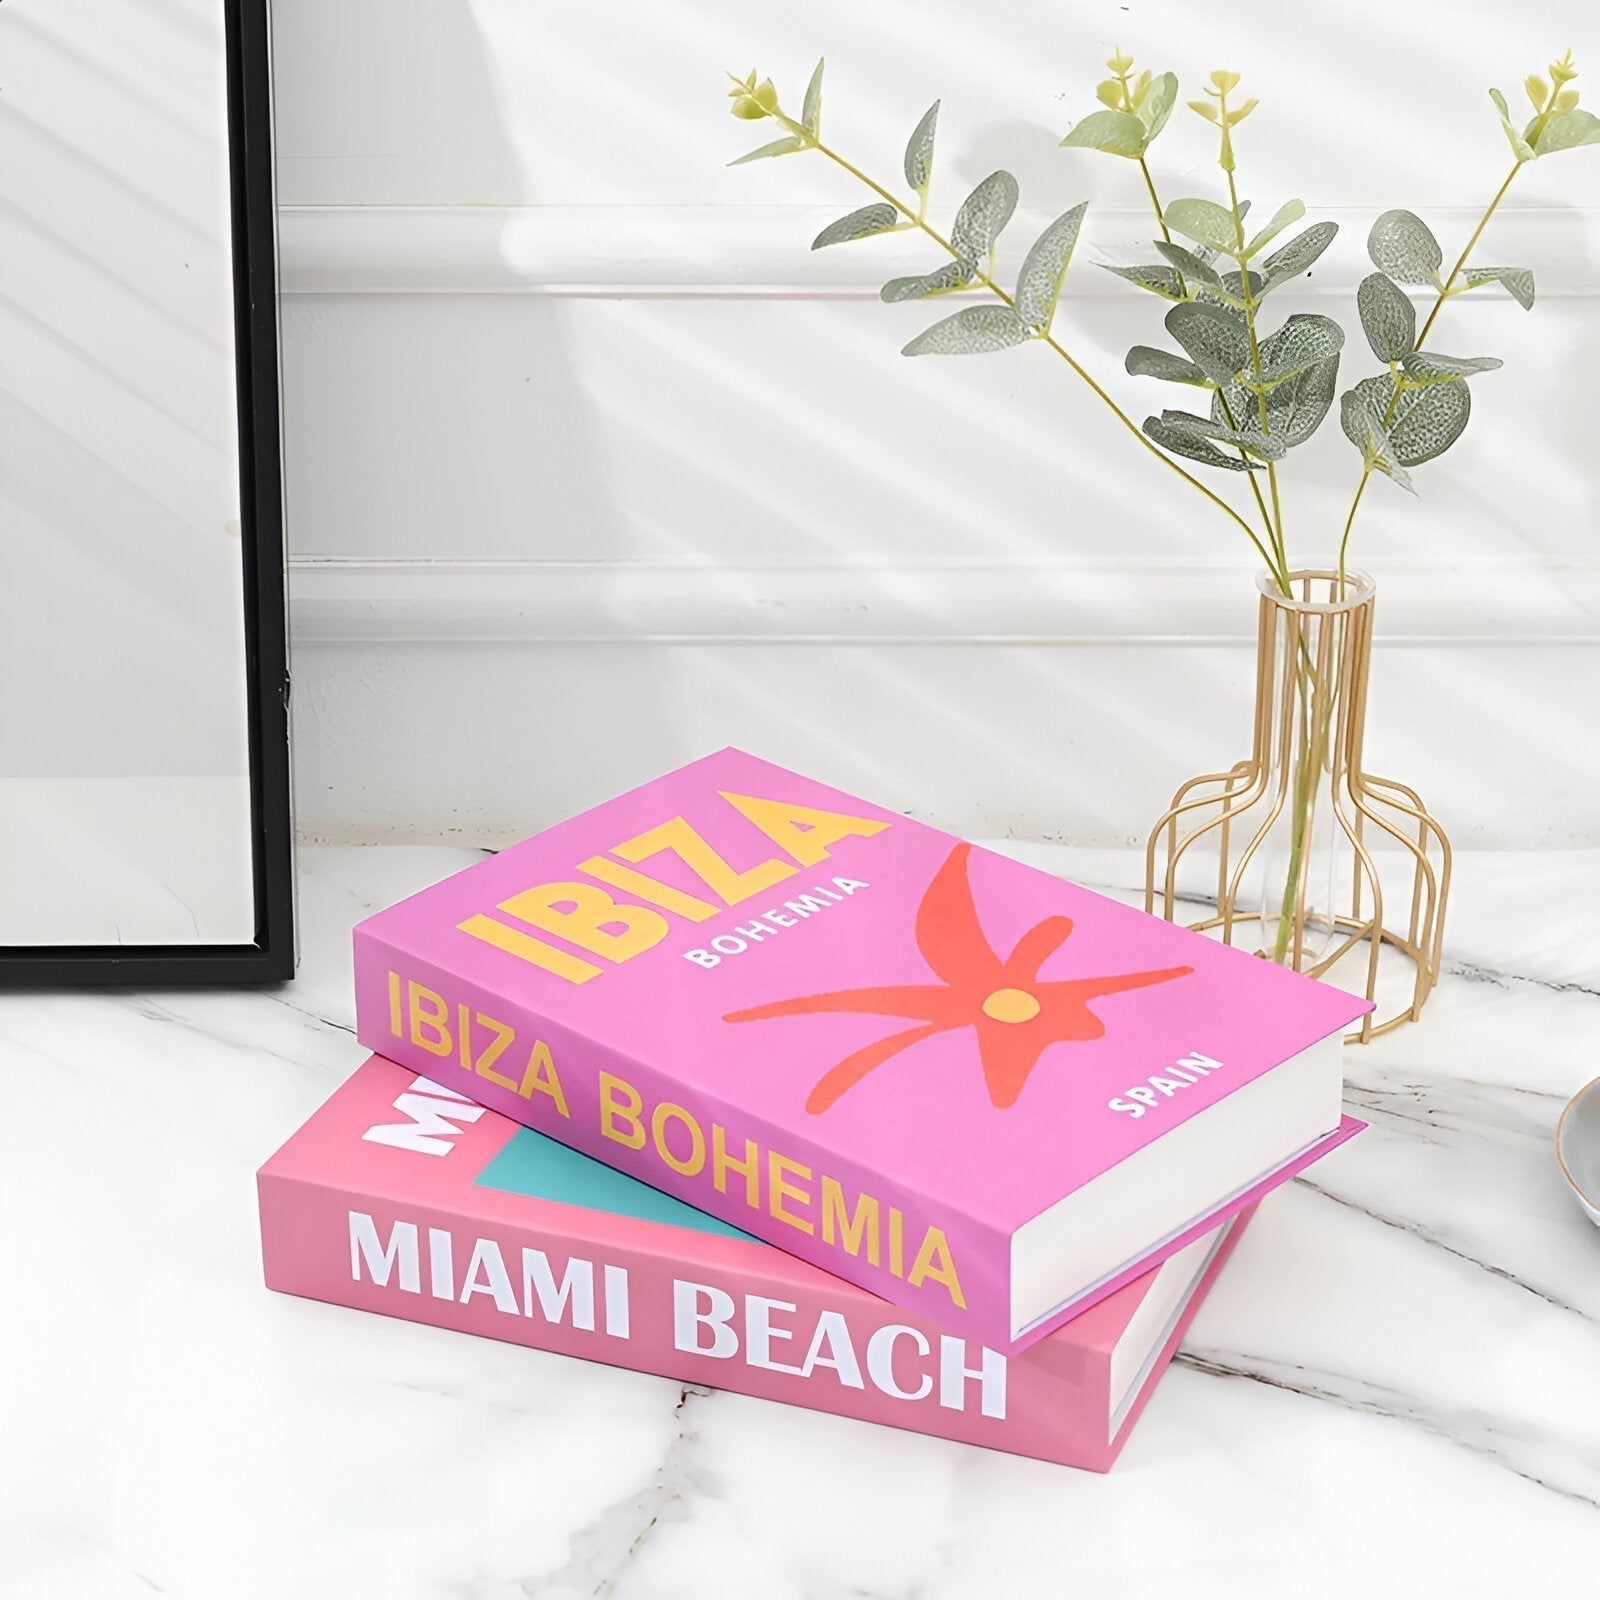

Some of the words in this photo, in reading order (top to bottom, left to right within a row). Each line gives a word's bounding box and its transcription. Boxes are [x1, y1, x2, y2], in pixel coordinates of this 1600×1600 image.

[456, 790, 893, 985] IBIZA
[682, 875, 869, 969] BOHEMIA
[388, 971, 570, 1119] IBIZA
[600, 1071, 967, 1310] BOHEMIA
[1108, 1051, 1223, 1119] SPAIN
[349, 1210, 630, 1340] MIAMI
[673, 1279, 1007, 1420] BEACH
